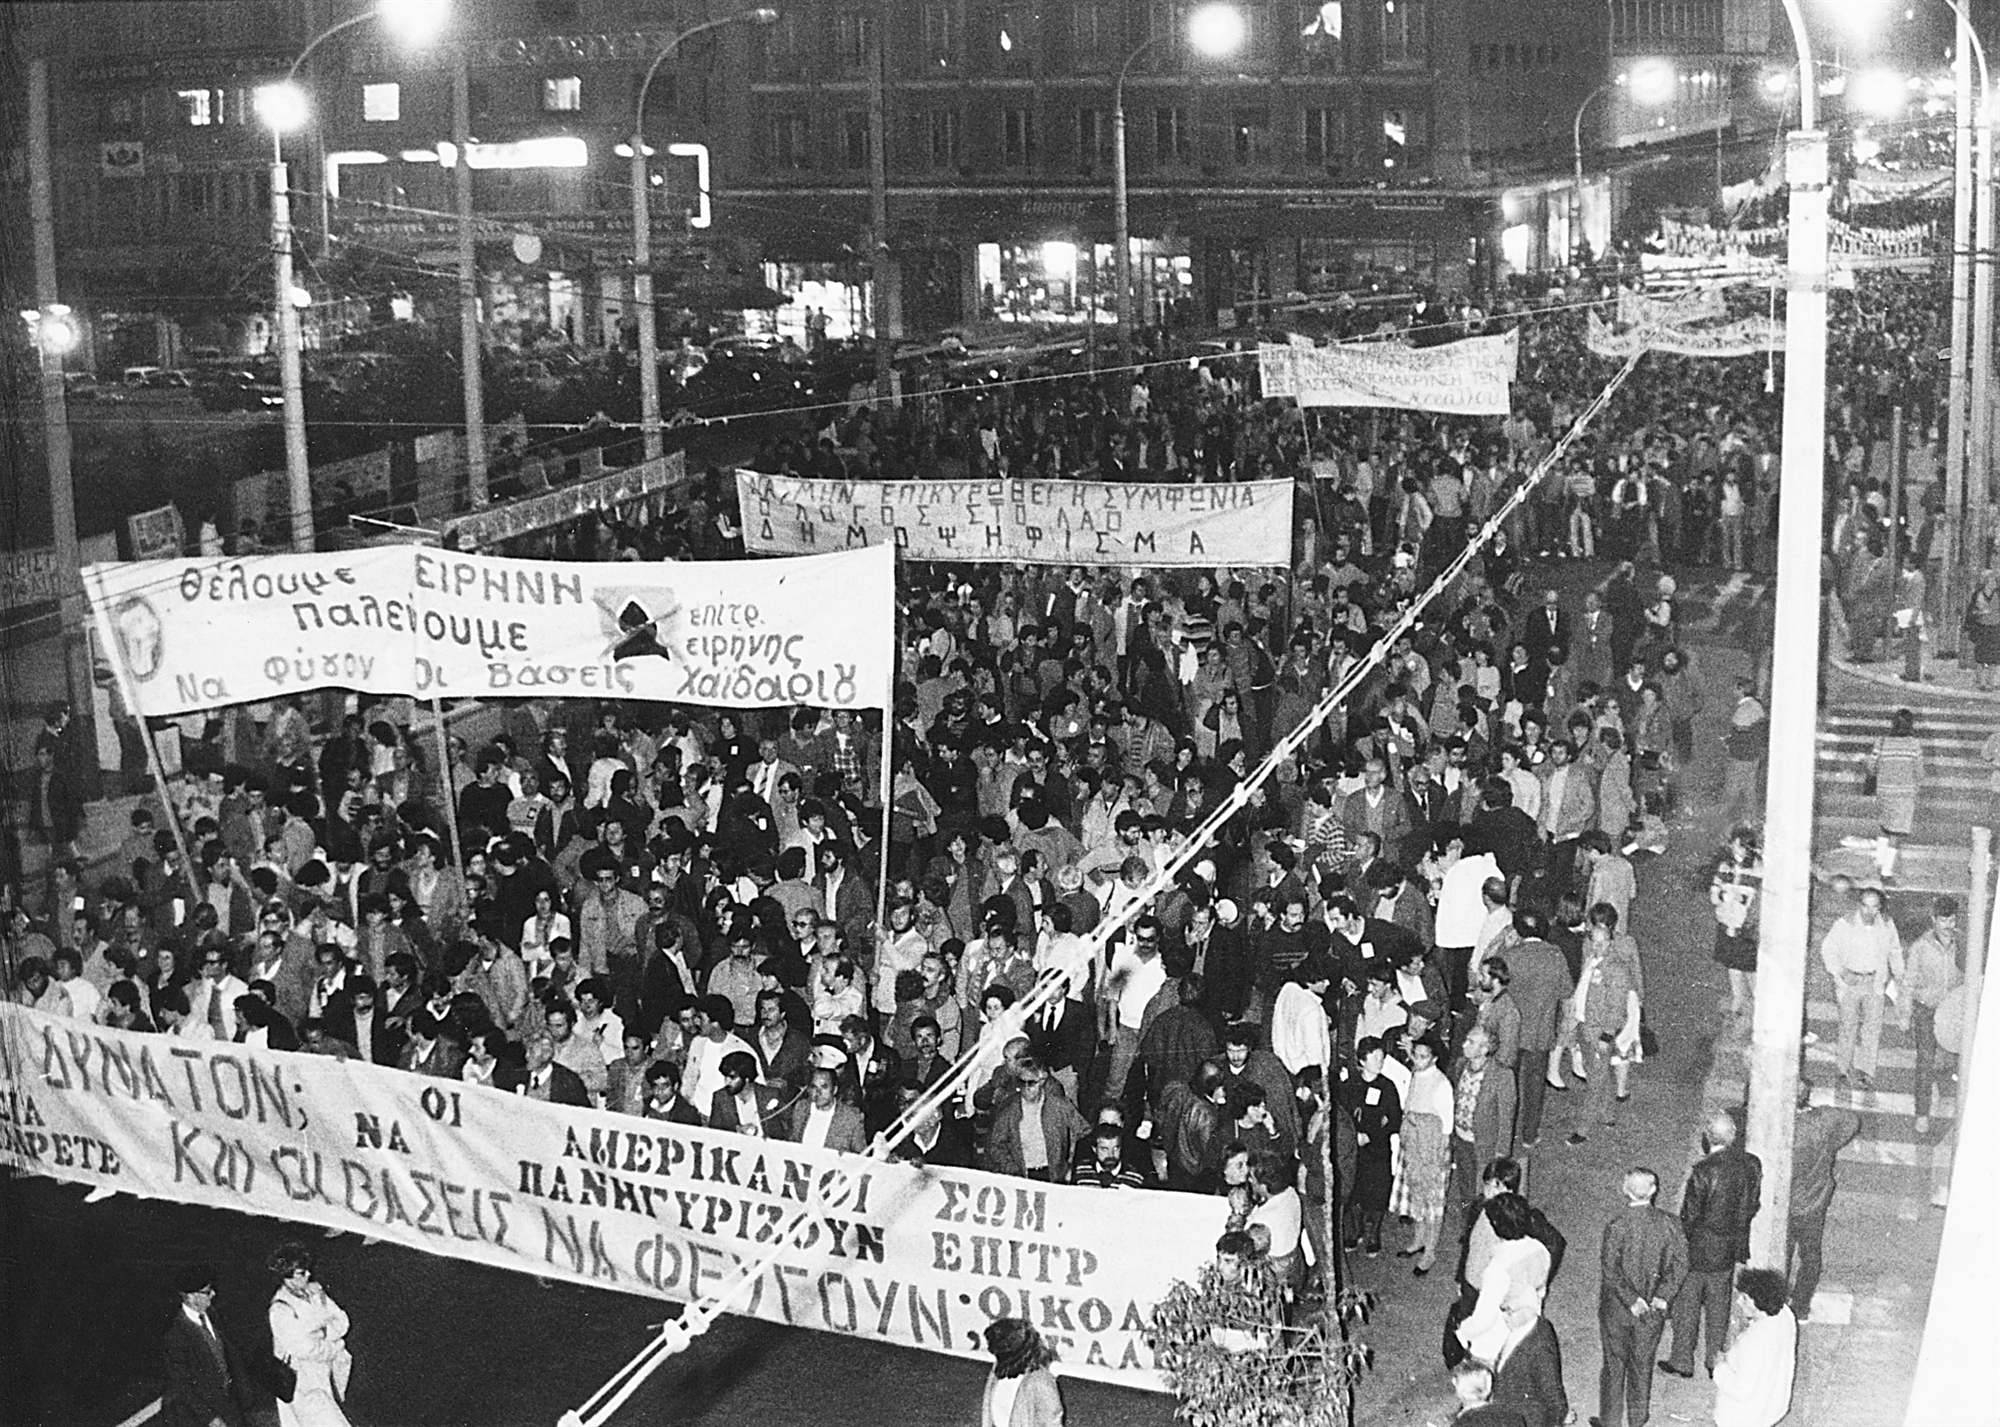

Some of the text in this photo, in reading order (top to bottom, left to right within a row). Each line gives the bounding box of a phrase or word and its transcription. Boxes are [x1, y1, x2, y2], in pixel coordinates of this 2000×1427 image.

[795, 481, 856, 504] ΜΗΝ
[1072, 484, 1086, 507] Η
[1104, 485, 1254, 512] ΣΥΜΦΩΝΙΑ
[415, 553, 583, 605] ΕΙΡΗΝΗ
[176, 673, 232, 703] Να
[421, 1086, 874, 1213] ΟΙ ΑΜΕΡΙΚΑΝΟΙ
[354, 1112, 886, 1263] ΝΑ ΠΑΝΗΓΥΡΙΖΟΥΝ
[341, 1158, 513, 1247] ΒΑΣΕΙΣ
[541, 1206, 618, 1283] ΝΑ
[931, 1231, 1099, 1288] ΕΠΙΤΡ
